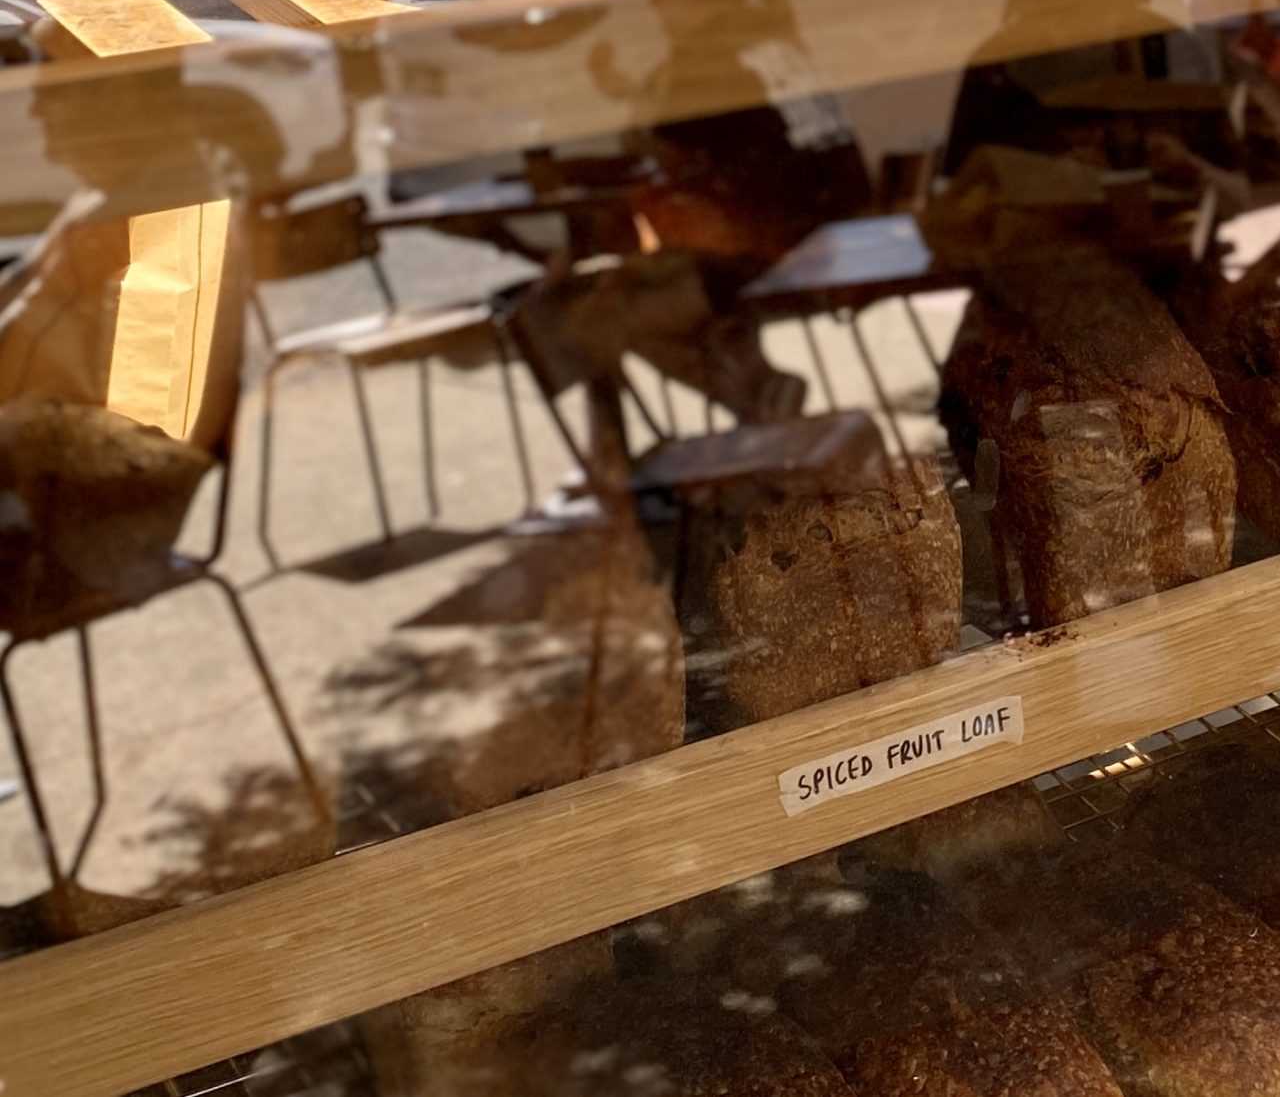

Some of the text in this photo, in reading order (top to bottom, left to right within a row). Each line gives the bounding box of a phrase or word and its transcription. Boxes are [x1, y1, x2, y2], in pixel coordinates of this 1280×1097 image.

[798, 707, 1011, 800] SPICED FRUIT LOAF
